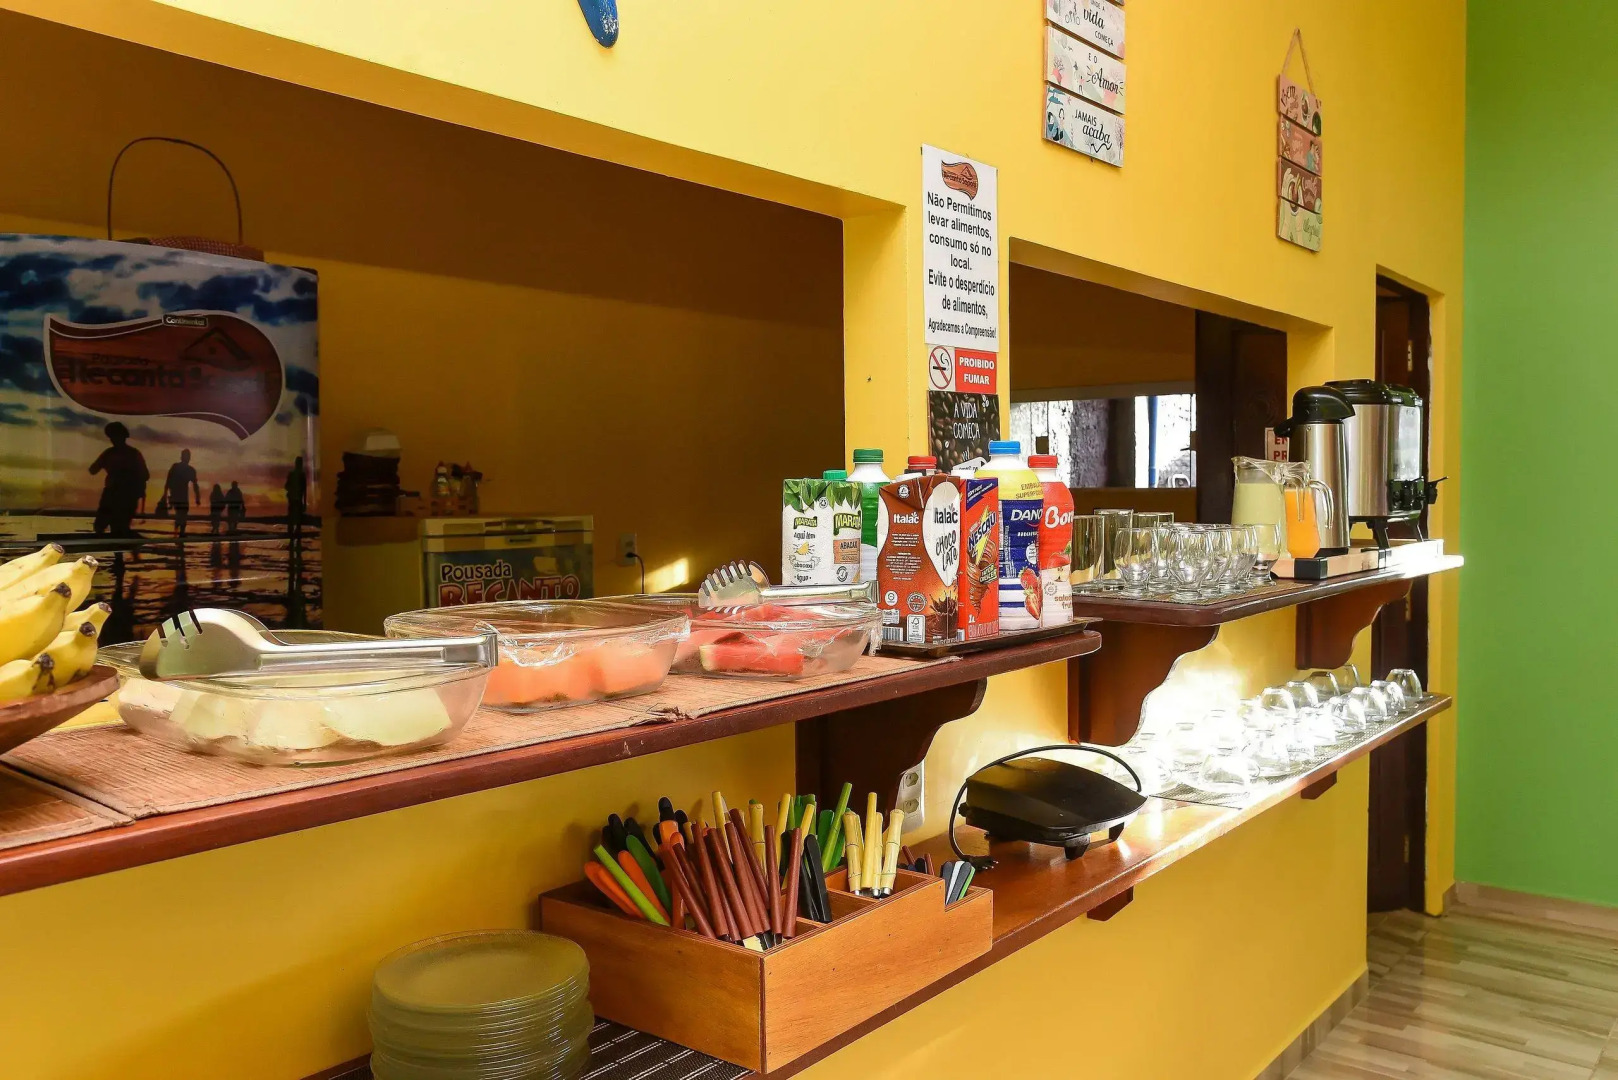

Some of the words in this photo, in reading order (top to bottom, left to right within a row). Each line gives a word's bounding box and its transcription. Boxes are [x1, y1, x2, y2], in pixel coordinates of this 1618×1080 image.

[1084, 9, 1105, 29] vida
[1095, 31, 1113, 47] COMEÇA
[1088, 53, 1091, 61] E
[1091, 68, 1118, 94] Amor
[1075, 109, 1097, 126] JAMAIS
[1082, 124, 1111, 144] acaba
[928, 191, 944, 208] Não
[947, 197, 992, 221] Permitimos
[928, 211, 948, 227] levar
[951, 218, 992, 241] alimentos,
[930, 233, 967, 251] consumo
[970, 242, 979, 254] só
[982, 246, 991, 257] no
[951, 254, 972, 270] local.
[929, 269, 946, 287] Evite
[949, 278, 953, 288] o
[942, 295, 951, 310] de
[928, 318, 960, 333] Agradecemos
[965, 323, 996, 339] Compreensão!
[960, 357, 994, 369] PROIBIDO
[964, 374, 990, 385] FUMAR
[954, 404, 959, 418] A
[961, 402, 977, 418] VIDA
[953, 423, 980, 440] COMEÇA
[894, 512, 919, 524] Italac
[934, 506, 958, 524] Italac
[968, 512, 997, 552] NESCAU
[441, 559, 512, 582] Pousada
